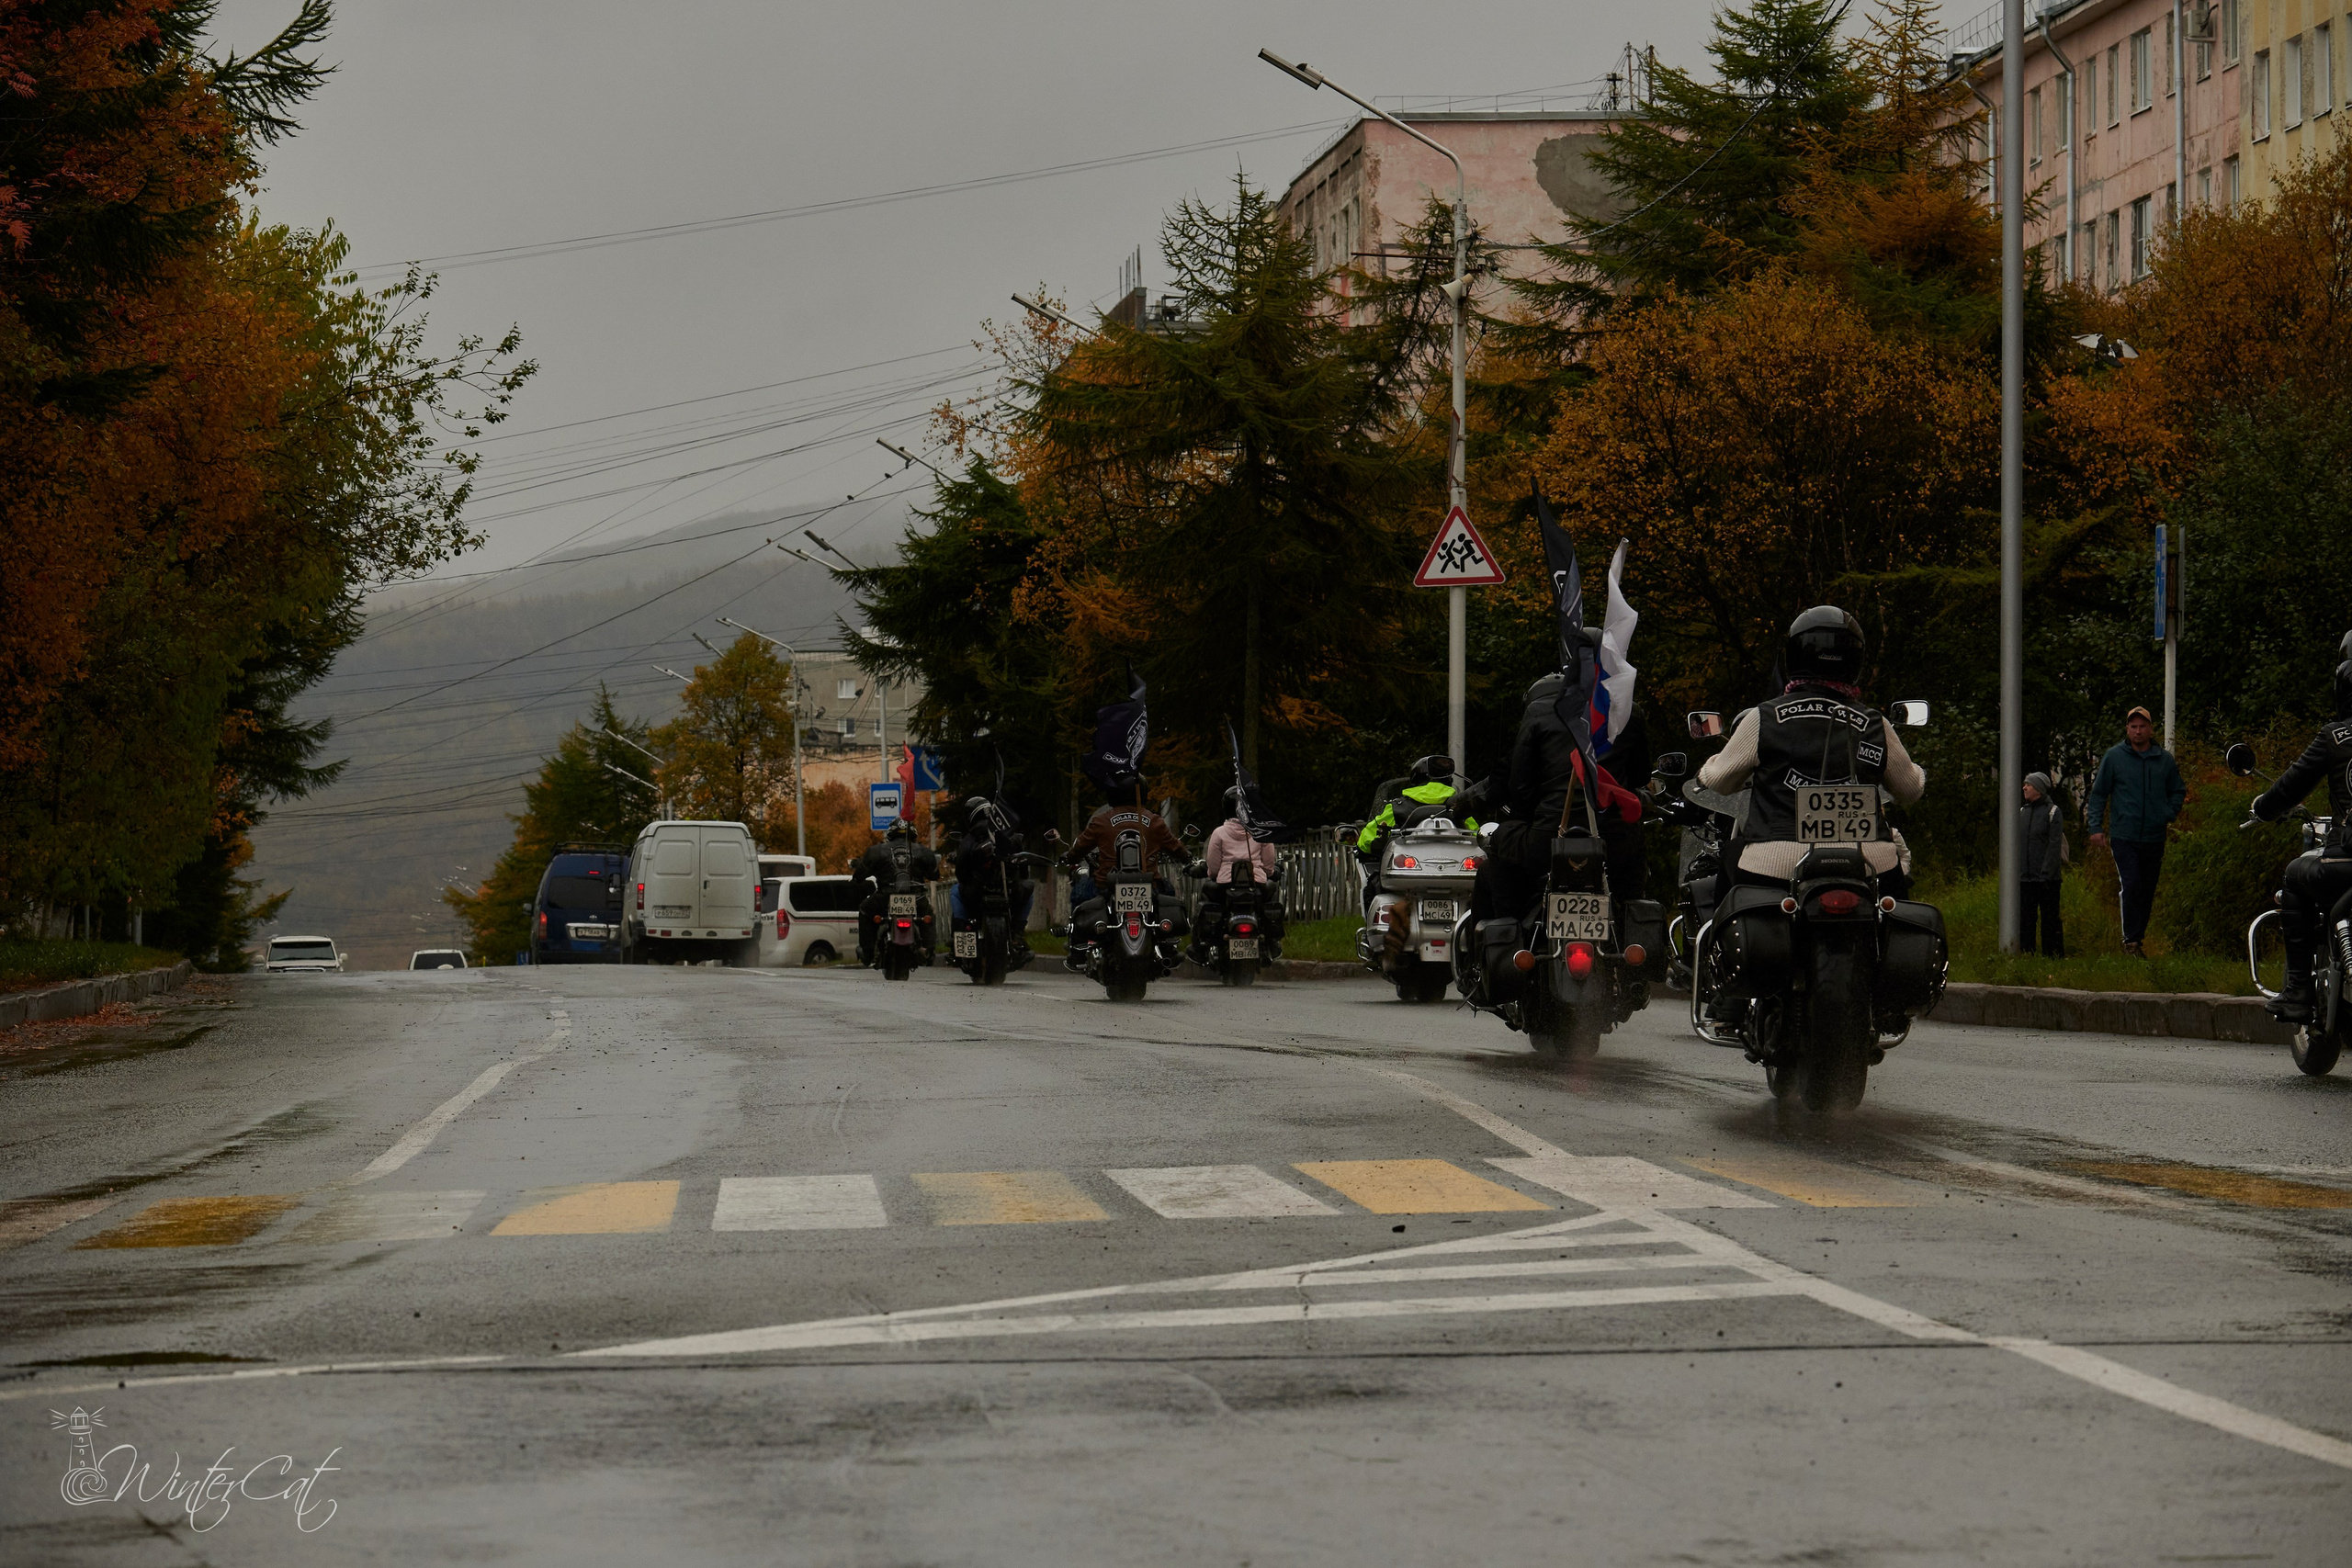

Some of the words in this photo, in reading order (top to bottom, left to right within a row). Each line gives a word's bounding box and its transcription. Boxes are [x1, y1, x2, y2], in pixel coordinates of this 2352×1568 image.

[1780, 703, 1824, 716] POLAR
[1859, 746, 1881, 761] MCC
[1808, 792, 1864, 811] 0335
[1112, 814, 1132, 824] POLAR
[1133, 815, 1149, 824] OLS
[1838, 810, 1859, 818] RUS
[1844, 818, 1871, 838] 49
[1121, 886, 1147, 897] 0372
[905, 906, 915, 914] 49
[1136, 900, 1149, 910] 49
[1427, 901, 1449, 909] 0086
[1557, 897, 1600, 915] 0228
[1440, 911, 1451, 919] 49
[1584, 921, 1605, 938] 49
[967, 933, 975, 943] 49
[956, 935, 965, 954] 0337
[1233, 940, 1255, 948] 0089
